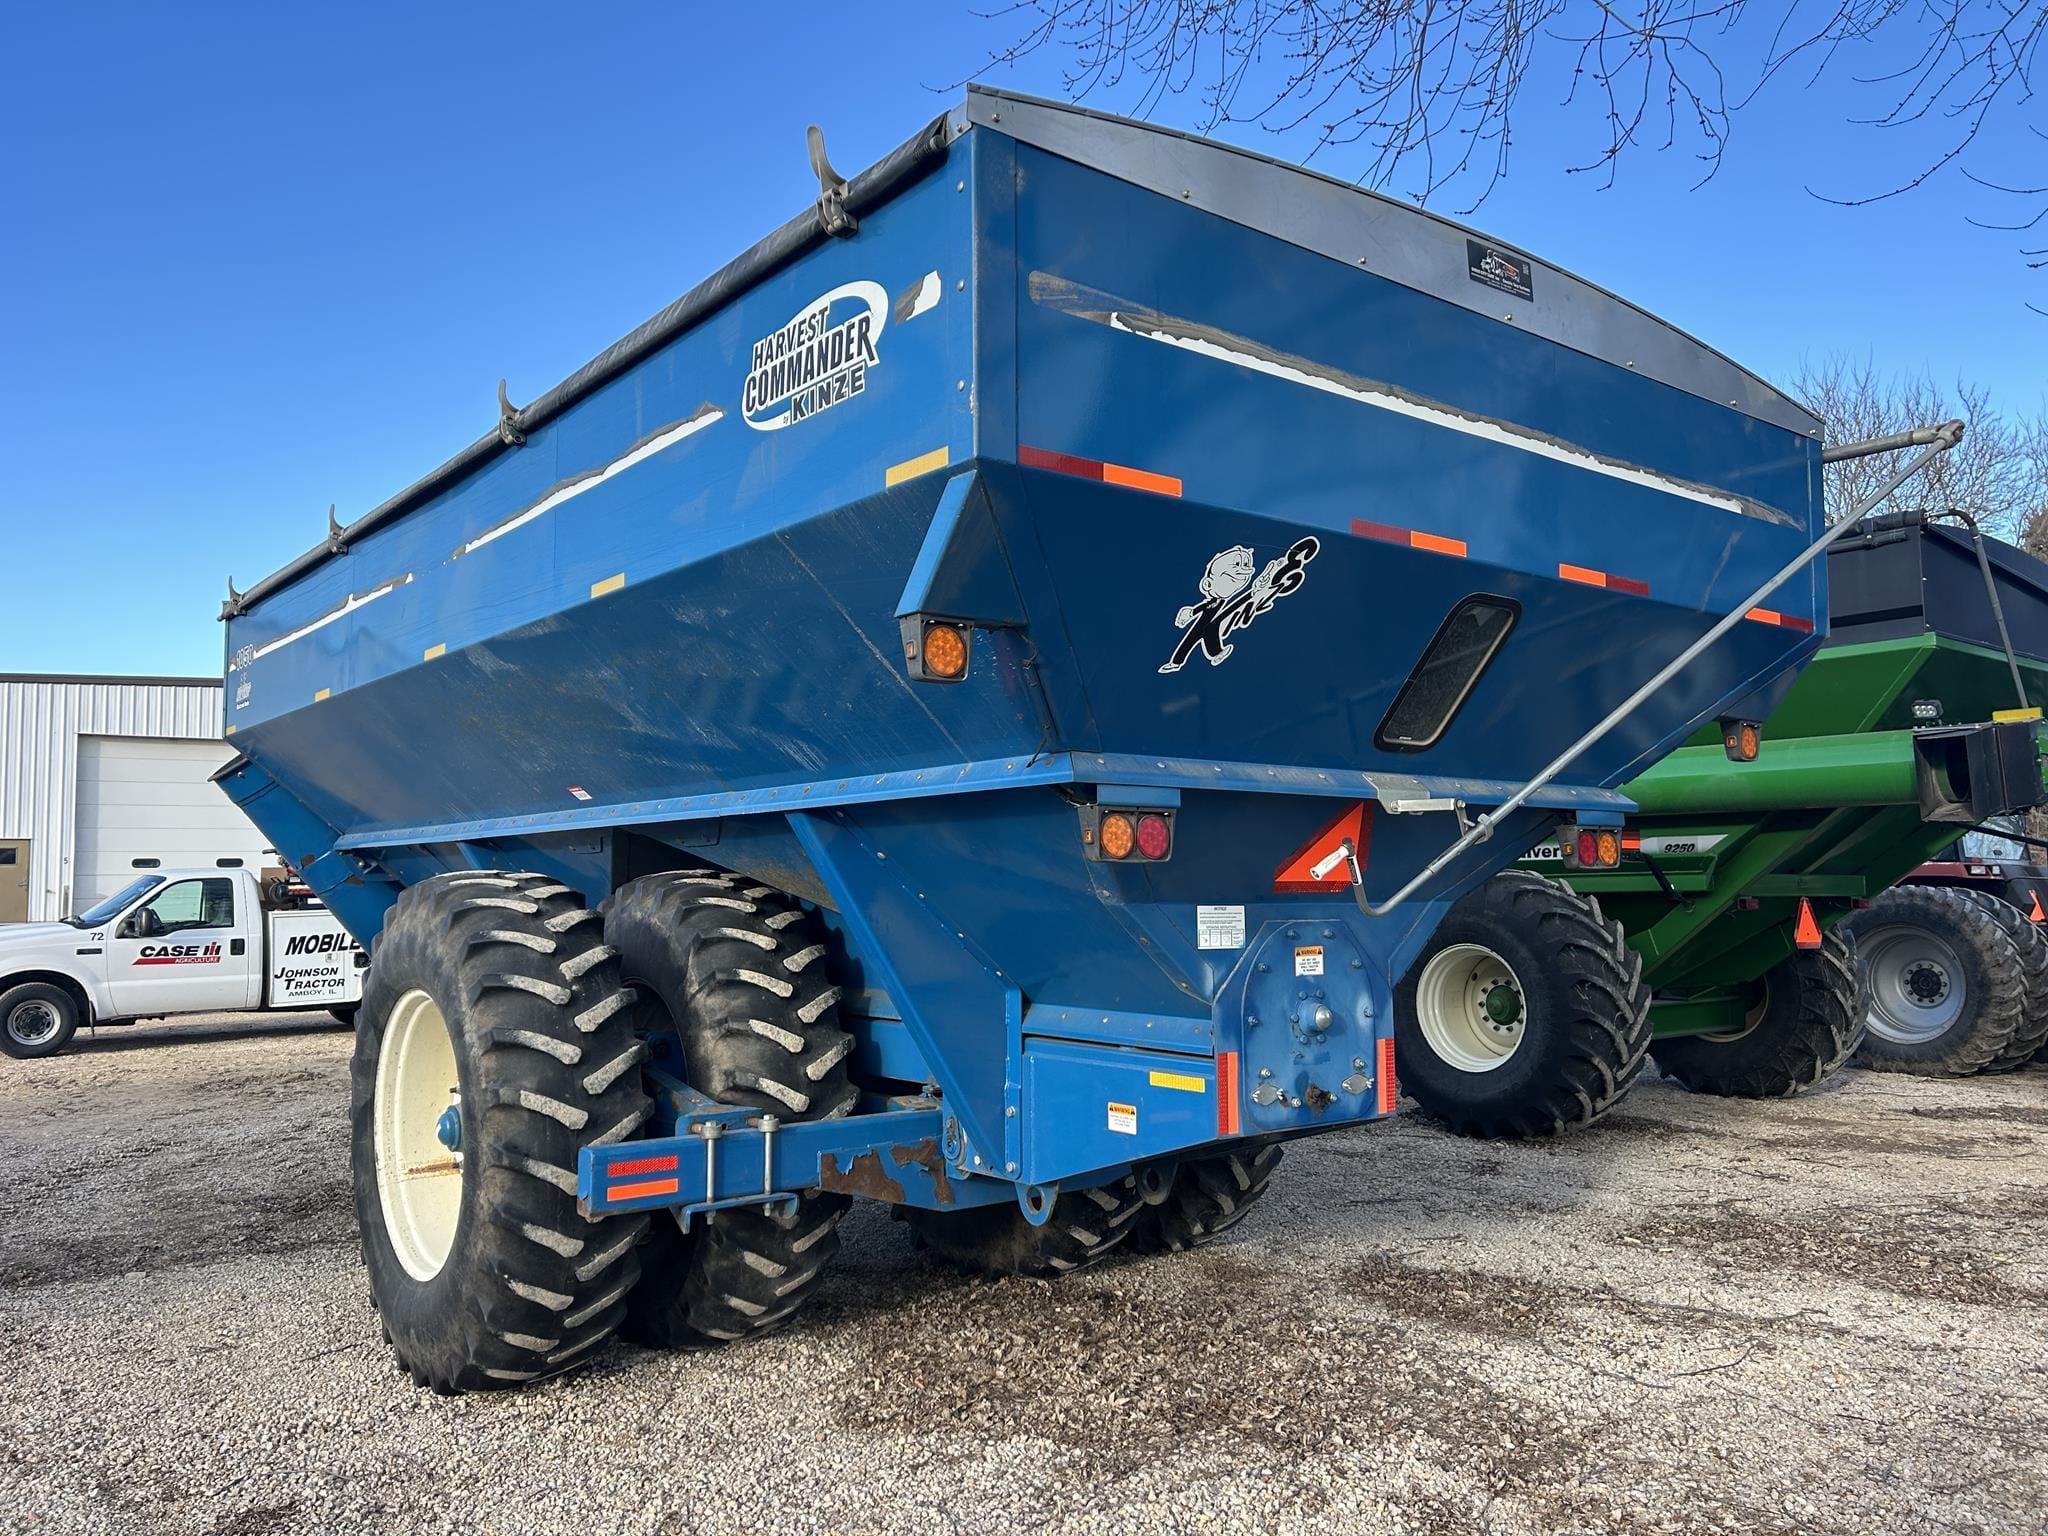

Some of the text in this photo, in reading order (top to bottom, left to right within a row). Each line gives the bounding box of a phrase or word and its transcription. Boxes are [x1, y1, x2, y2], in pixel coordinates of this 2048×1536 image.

[753, 305, 829, 372] HARVEST
[745, 315, 876, 413] COMMANDER
[792, 366, 865, 422] KINZE
[1664, 843, 1695, 853] 9250
[90, 932, 104, 941] 72
[285, 932, 361, 955] MOBILE
[140, 945, 200, 957] CASE
[175, 956, 220, 964] AGRICULTURE
[274, 967, 339, 979] JOHNSON
[284, 978, 345, 990] TRACTOR
[288, 989, 325, 997] AMBOY,
